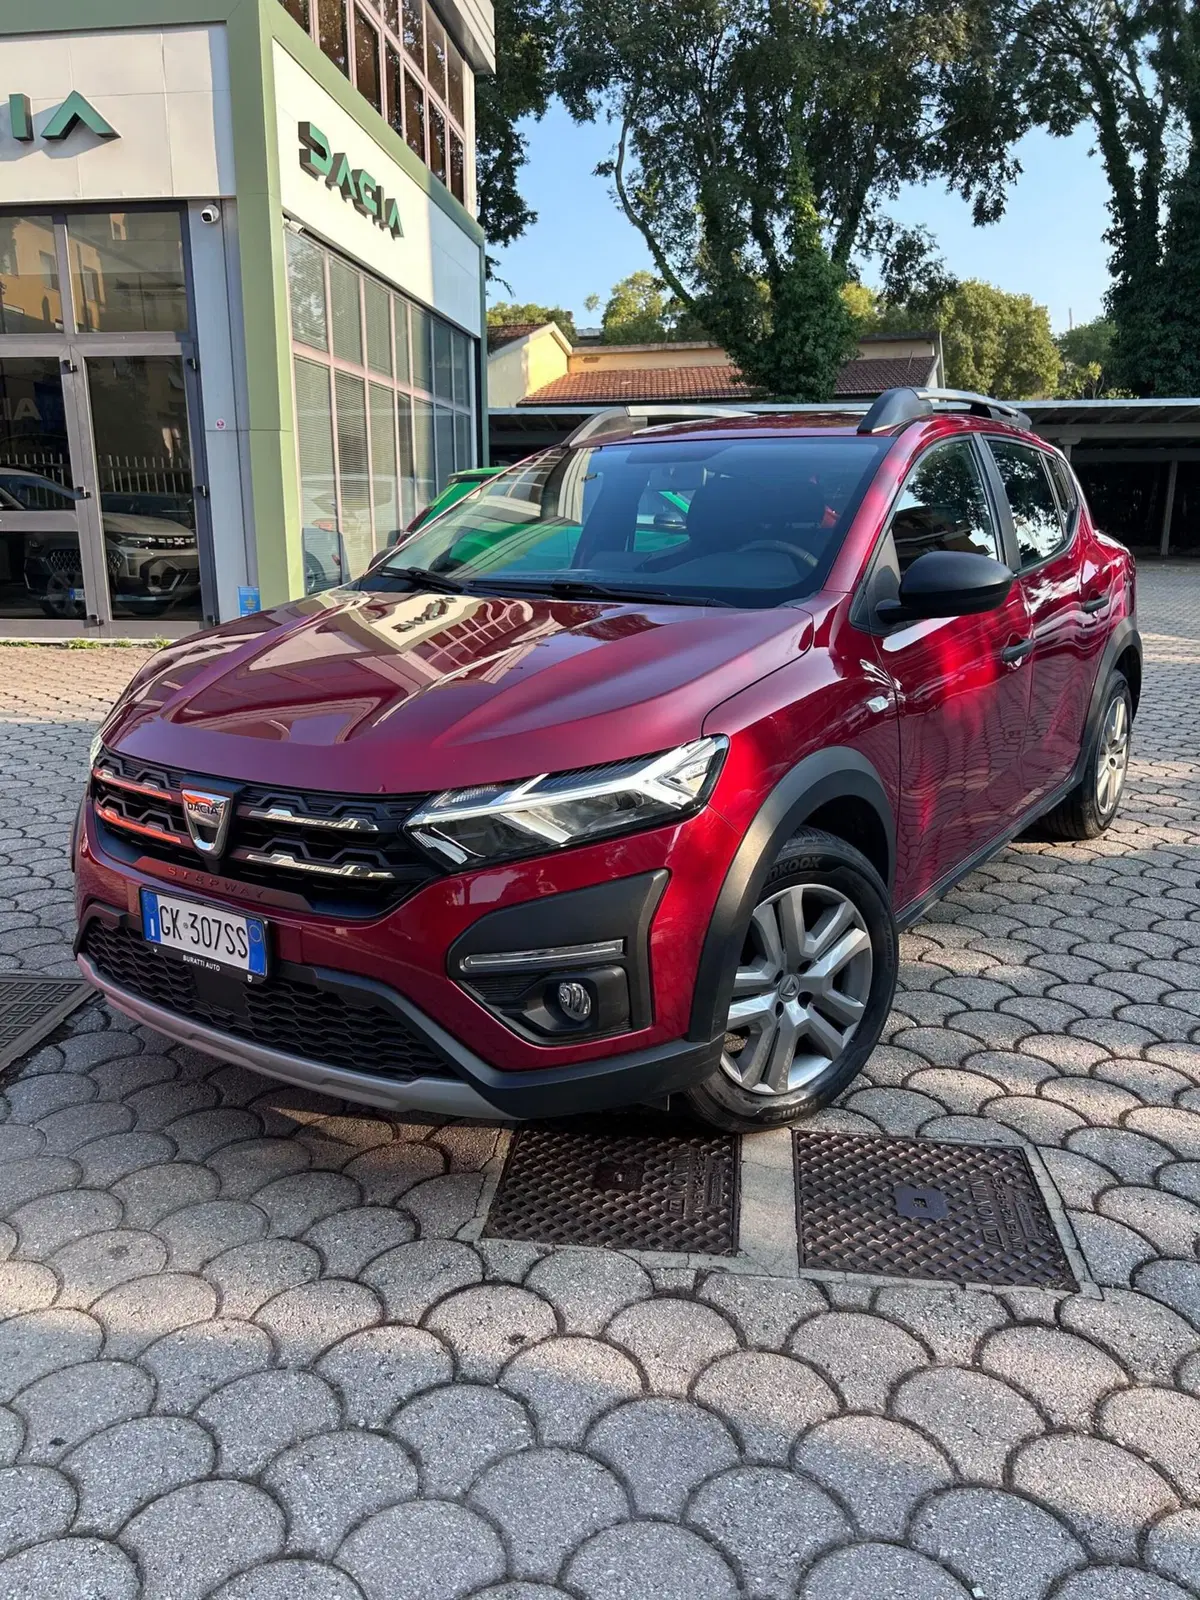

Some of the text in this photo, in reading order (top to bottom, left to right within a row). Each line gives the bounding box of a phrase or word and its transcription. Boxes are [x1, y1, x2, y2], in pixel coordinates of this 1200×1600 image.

[298, 121, 404, 240] DACIA
[187, 802, 219, 816] DACIA
[168, 867, 265, 898] STEPWAY
[182, 954, 221, 972] BURATTI AUTO
